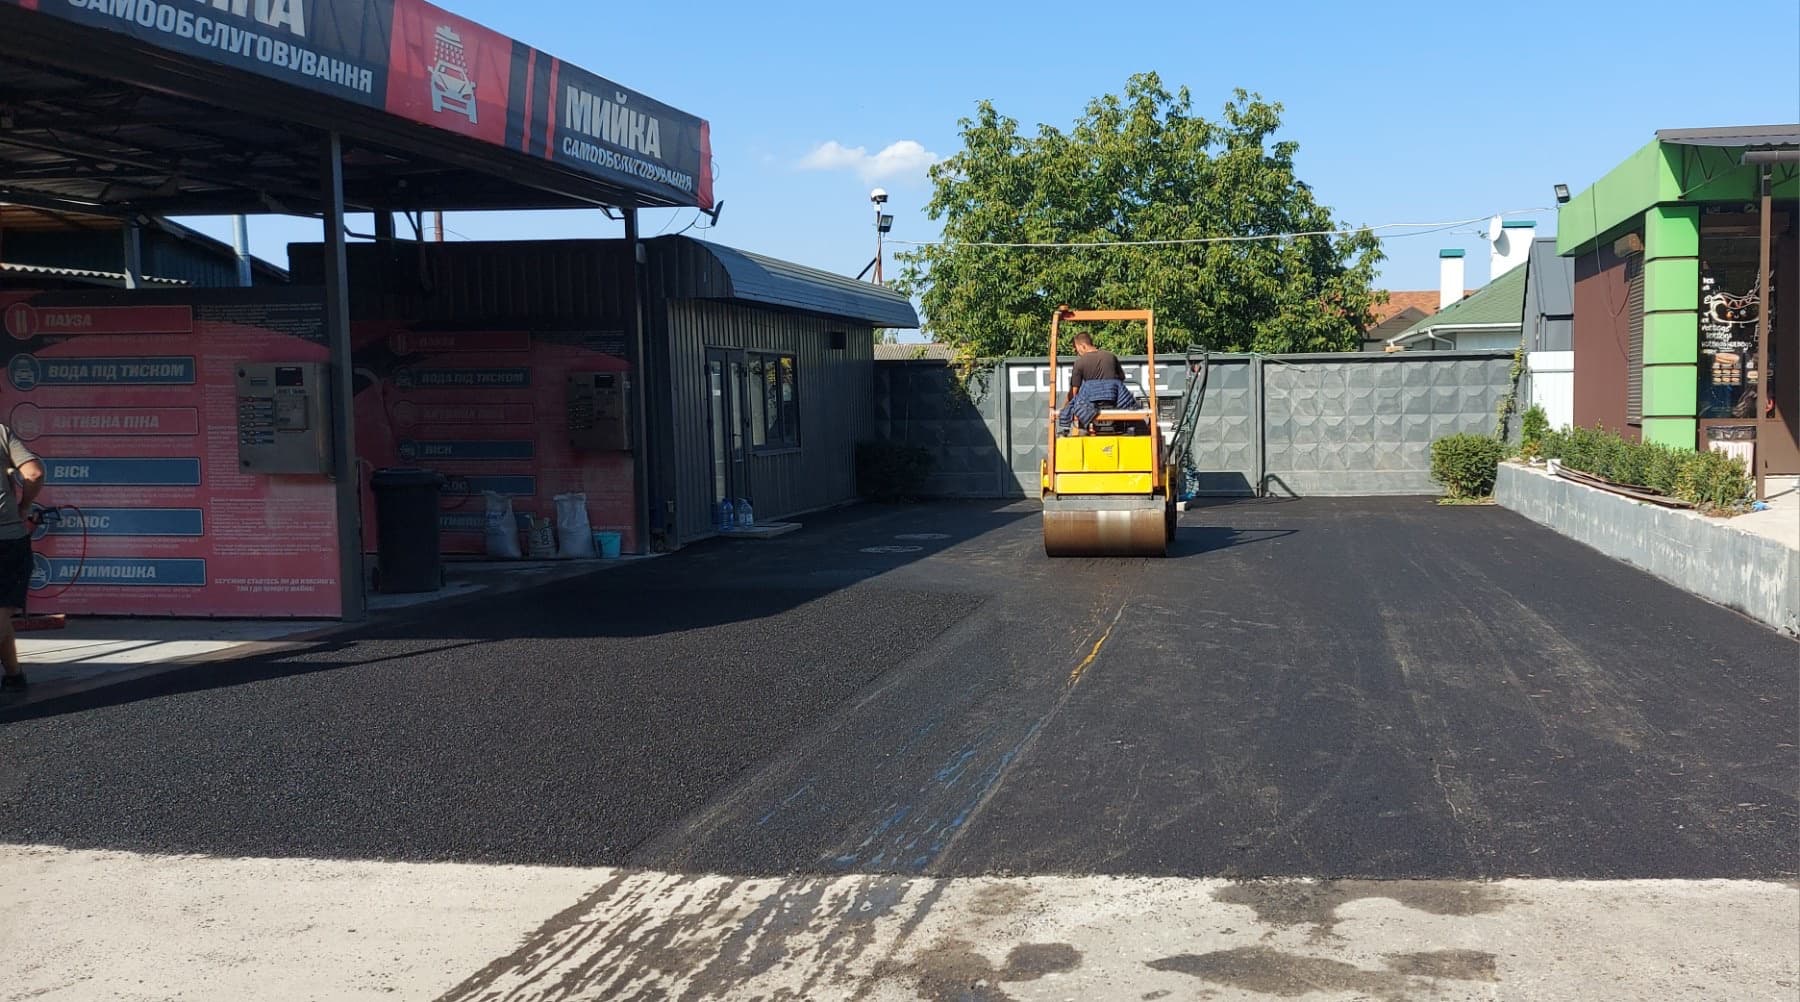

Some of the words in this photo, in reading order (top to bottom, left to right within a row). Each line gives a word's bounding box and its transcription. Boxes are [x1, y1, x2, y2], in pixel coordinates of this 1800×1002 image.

[68, 0, 373, 94] МООБСЛУГОВУВАННЯ
[565, 85, 662, 159] МИЙКА
[562, 136, 693, 192] САМООБСЛУГОВУВАННЯ
[45, 313, 92, 327] ПАУЗА
[47, 364, 89, 380] ВОДА
[91, 364, 117, 380] ПІД
[119, 363, 185, 377] ТИСКОМ
[53, 415, 122, 429] АКТИВНА
[123, 415, 160, 428] ПІНА
[54, 465, 90, 478] ВІСК
[59, 565, 157, 579] АНТИМОШКА
